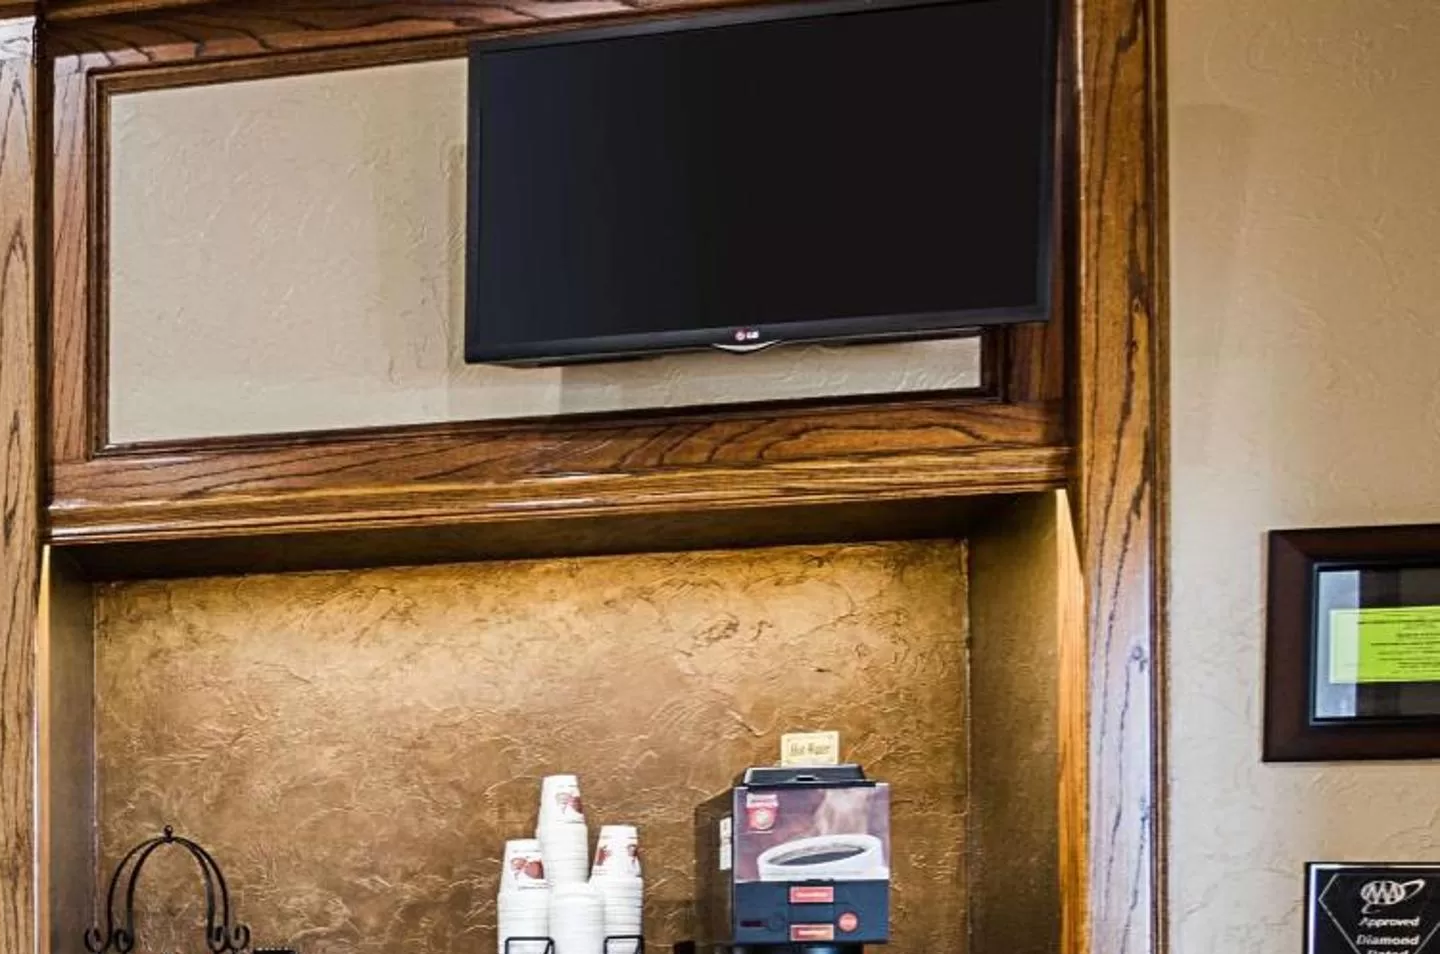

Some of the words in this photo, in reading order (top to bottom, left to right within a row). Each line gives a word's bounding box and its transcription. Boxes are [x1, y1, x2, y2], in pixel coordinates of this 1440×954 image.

[1361, 880, 1406, 905] AAA
[1358, 915, 1420, 928] Approved
[1356, 935, 1420, 946] Diamond
